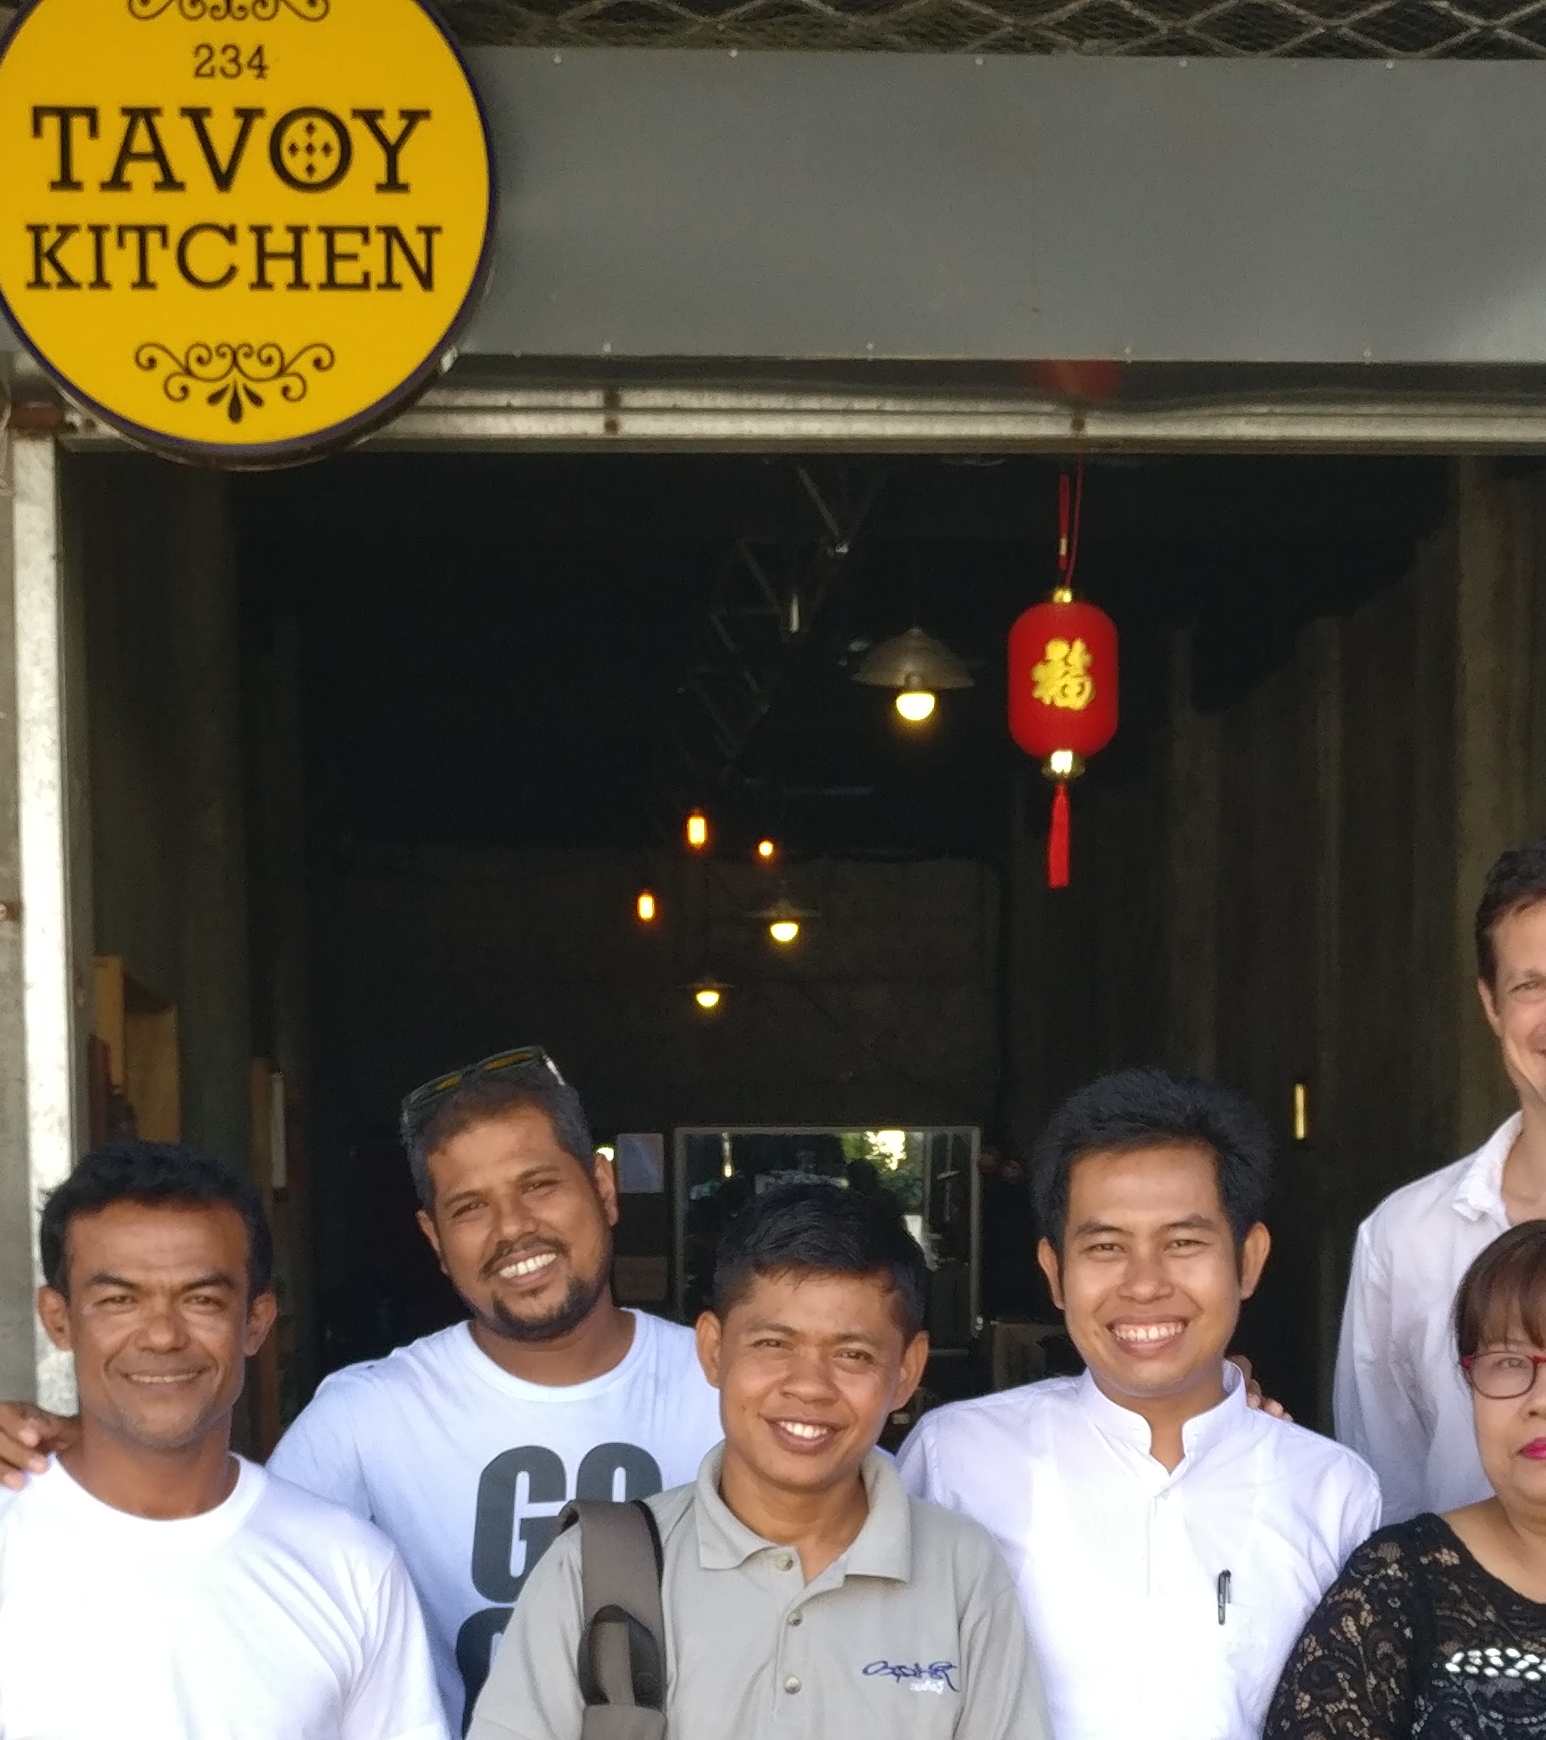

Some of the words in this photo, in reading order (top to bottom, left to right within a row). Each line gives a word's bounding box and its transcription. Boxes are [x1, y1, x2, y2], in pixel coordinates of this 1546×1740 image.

[192, 43, 270, 80] 234
[30, 105, 432, 194] TAVOY
[25, 223, 443, 292] KITCHEN
[1031, 637, 1096, 711] 福
